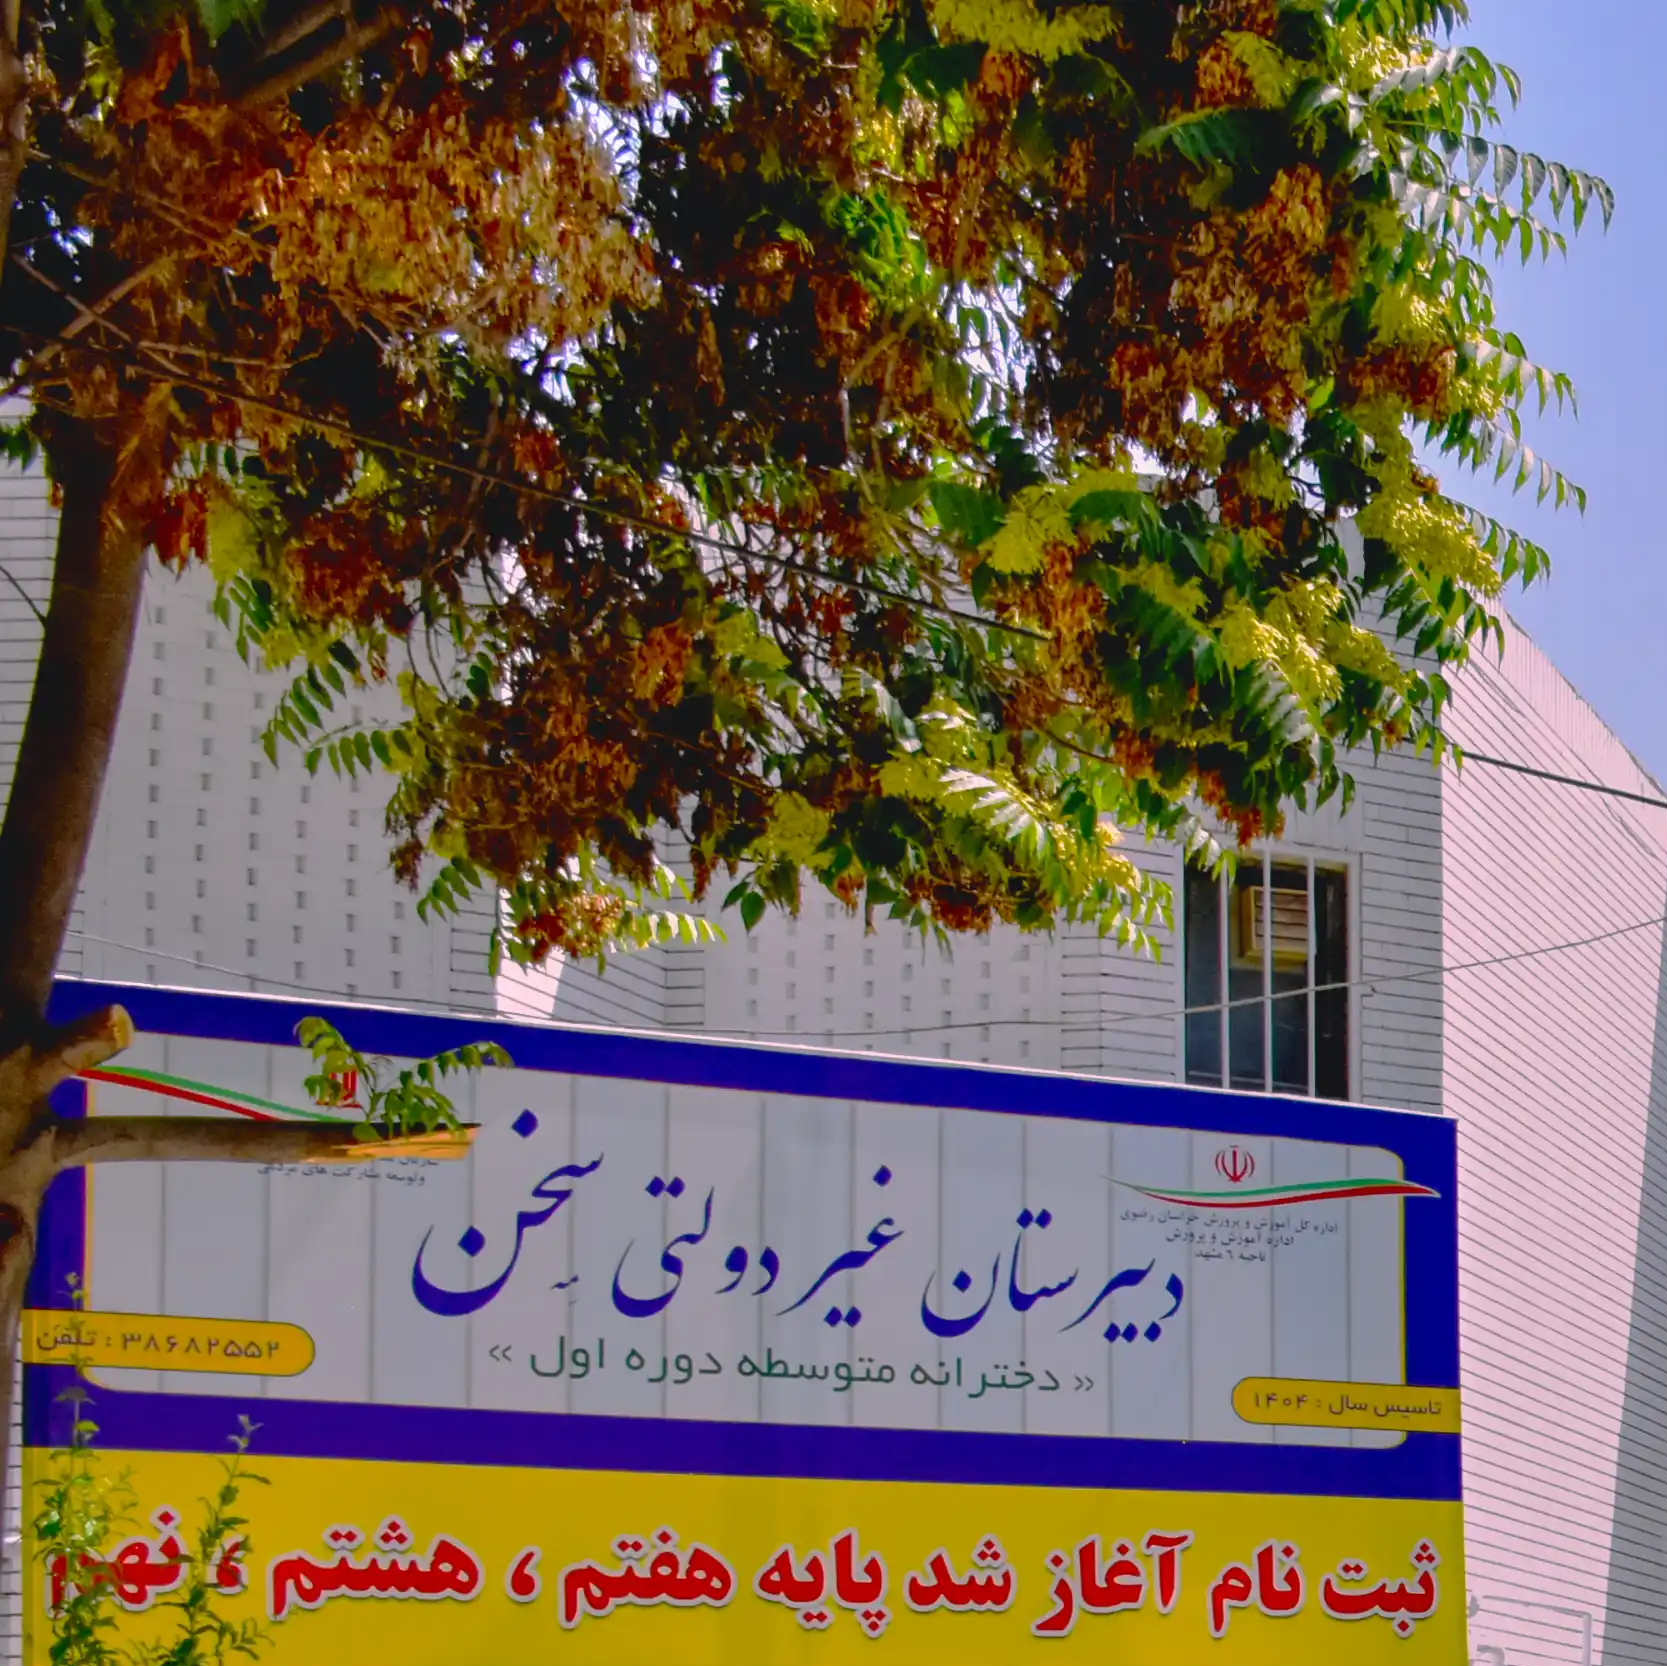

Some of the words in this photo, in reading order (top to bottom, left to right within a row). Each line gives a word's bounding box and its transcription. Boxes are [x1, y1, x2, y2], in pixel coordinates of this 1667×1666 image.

[411, 1109, 605, 1318] سخن
[1254, 1215, 1291, 1232] آموزش
[1294, 1219, 1310, 1234] کل
[1313, 1221, 1338, 1236] اداره
[610, 1174, 780, 1319] دولتی
[776, 1165, 904, 1328] غیر
[1221, 1229, 1263, 1248] آموزش
[1266, 1233, 1294, 1247] اداره
[920, 1207, 1185, 1344] دبیرستان
[121, 1332, 280, 1359] ۳۸۶۸۲۵۵۲
[529, 1335, 606, 1380] اول
[623, 1347, 724, 1386] دوره
[735, 1345, 896, 1394] متوسطه
[908, 1356, 1062, 1399] دخترانه
[1254, 1392, 1307, 1409] ۱۴۰۴
[1328, 1395, 1368, 1416] سال
[1373, 1400, 1443, 1420] تاسیس
[272, 1518, 480, 1617] هشتم
[564, 1529, 732, 1623] هفتم
[756, 1532, 885, 1635] پایه
[907, 1537, 1012, 1608] شد
[1033, 1532, 1190, 1634] آغاز
[1210, 1541, 1302, 1633] نام
[1322, 1541, 1437, 1636] ثبت
